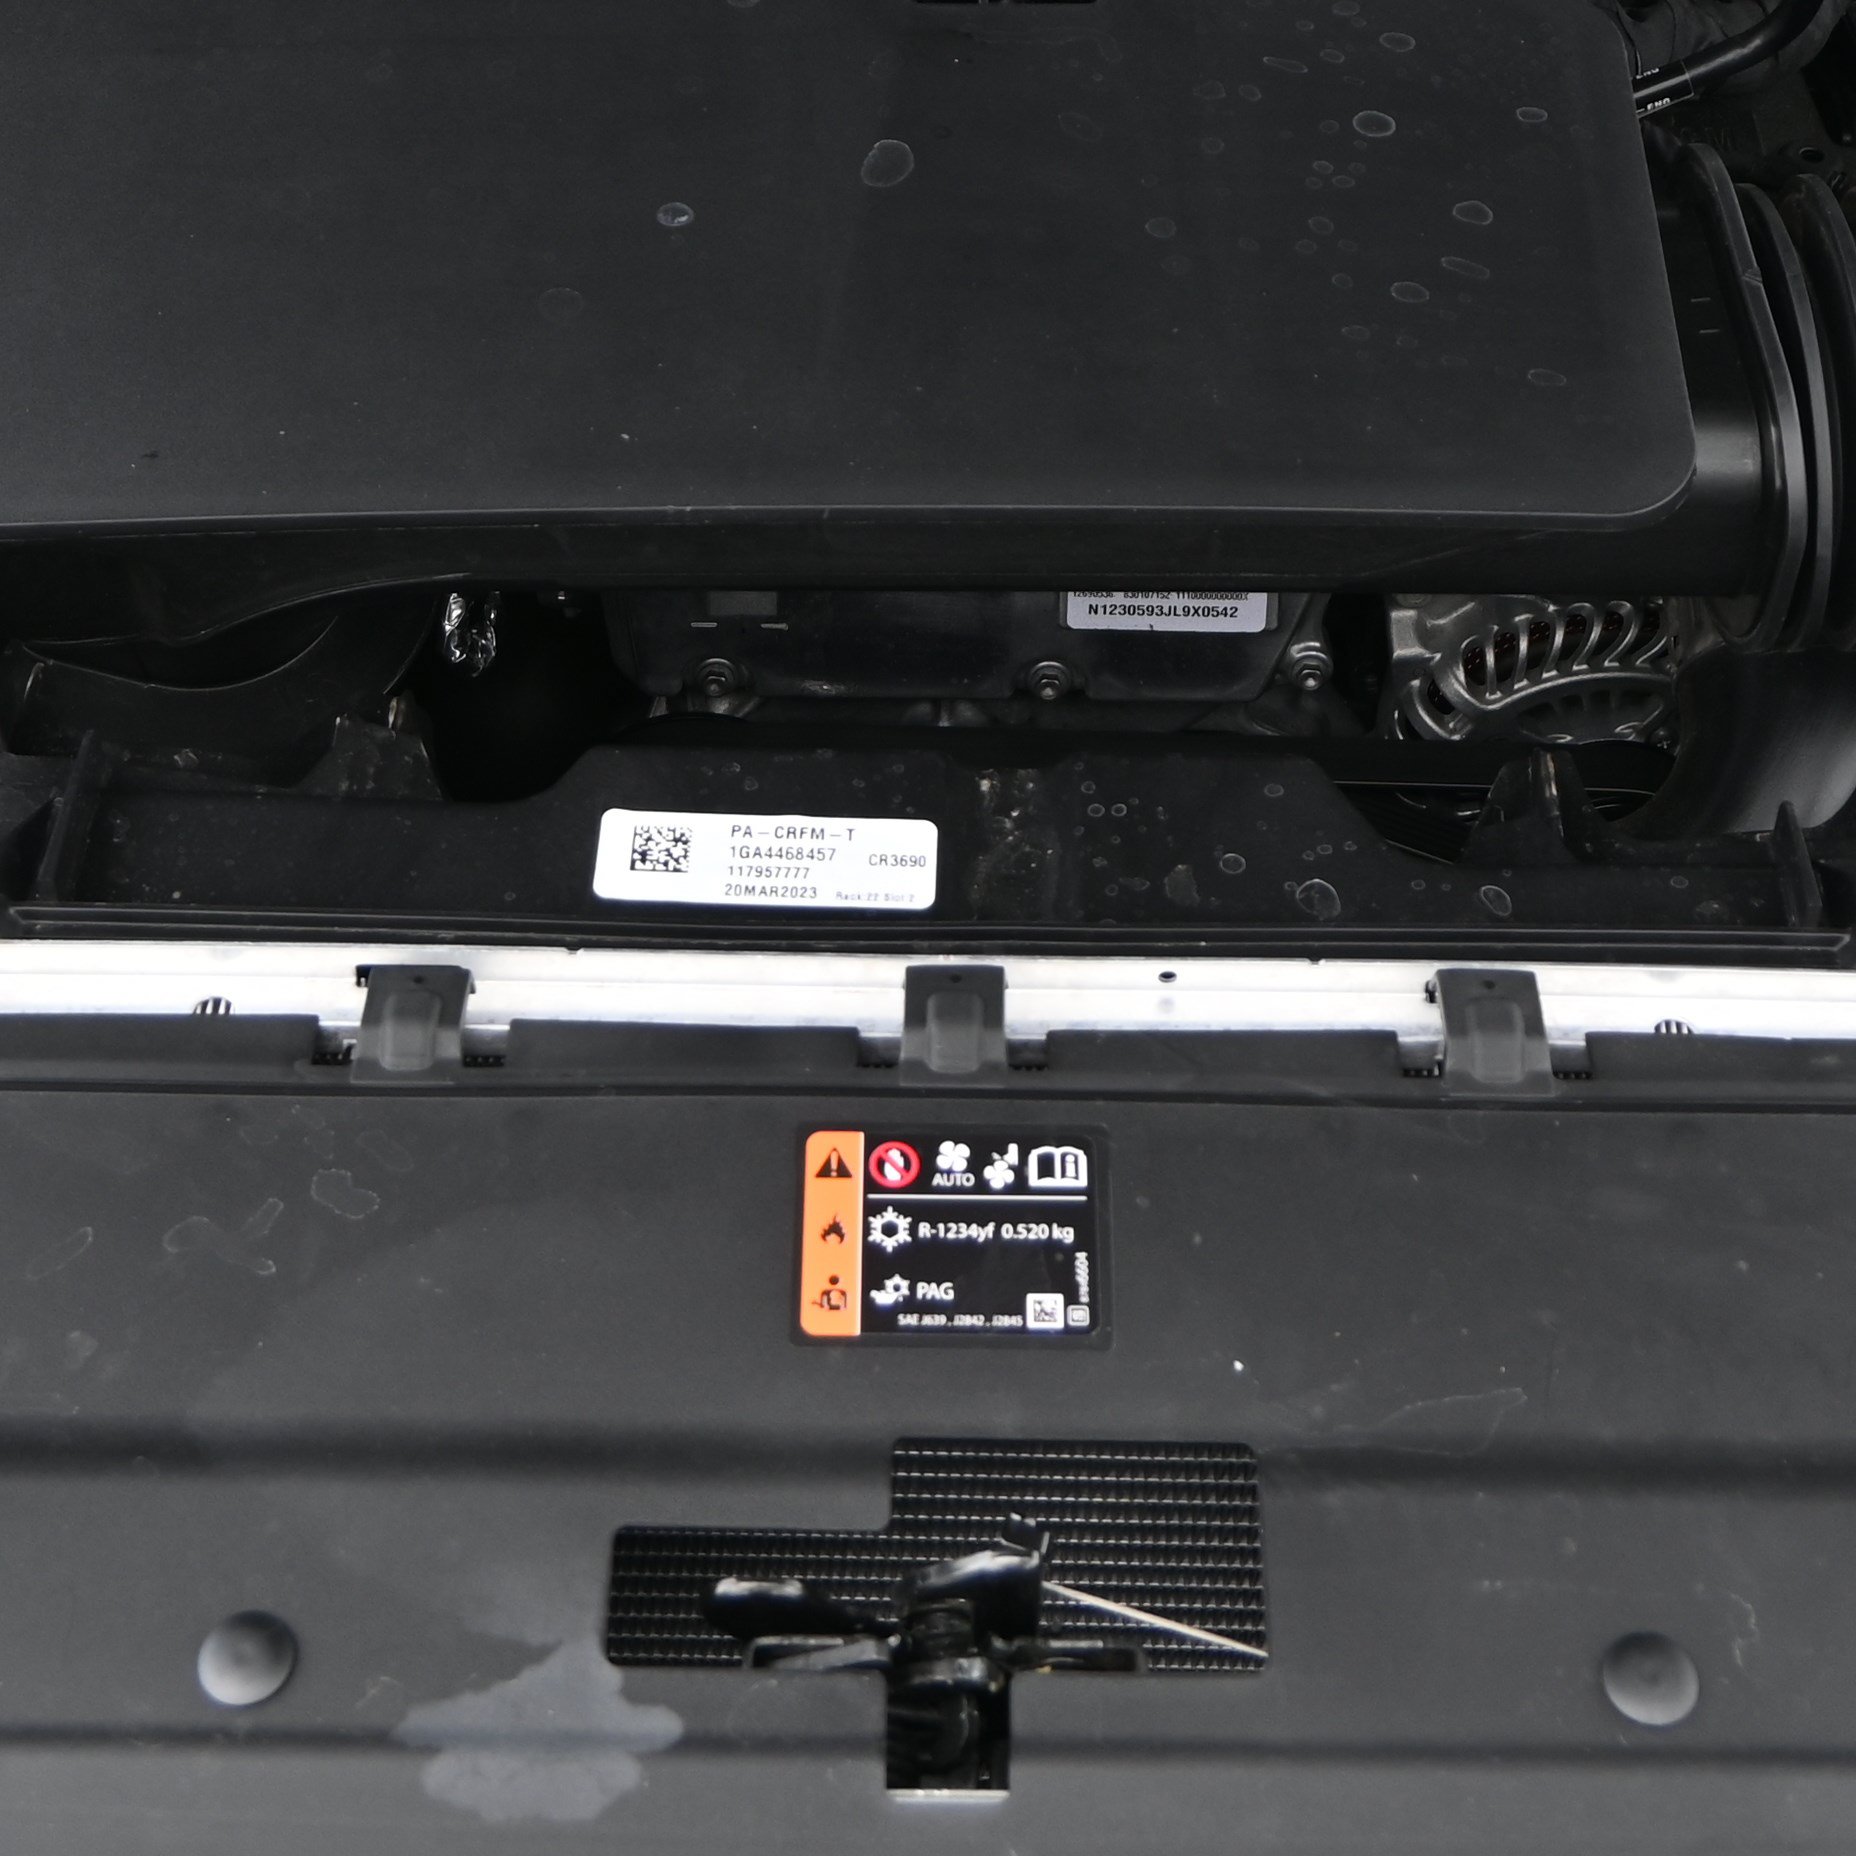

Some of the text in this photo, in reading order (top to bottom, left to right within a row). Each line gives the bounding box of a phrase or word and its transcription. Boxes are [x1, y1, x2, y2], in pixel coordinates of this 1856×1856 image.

[1088, 604, 1239, 618] N1230593JL9X0542
[729, 845, 836, 861] 1GA4468457
[868, 853, 927, 867] CR3690
[728, 865, 810, 880] 117957777
[724, 883, 818, 899] 20MAR2023
[932, 1171, 975, 1187] AUTO
[917, 1223, 1075, 1244] R-1234yf 0.520 kg
[916, 1282, 955, 1300] PAG
